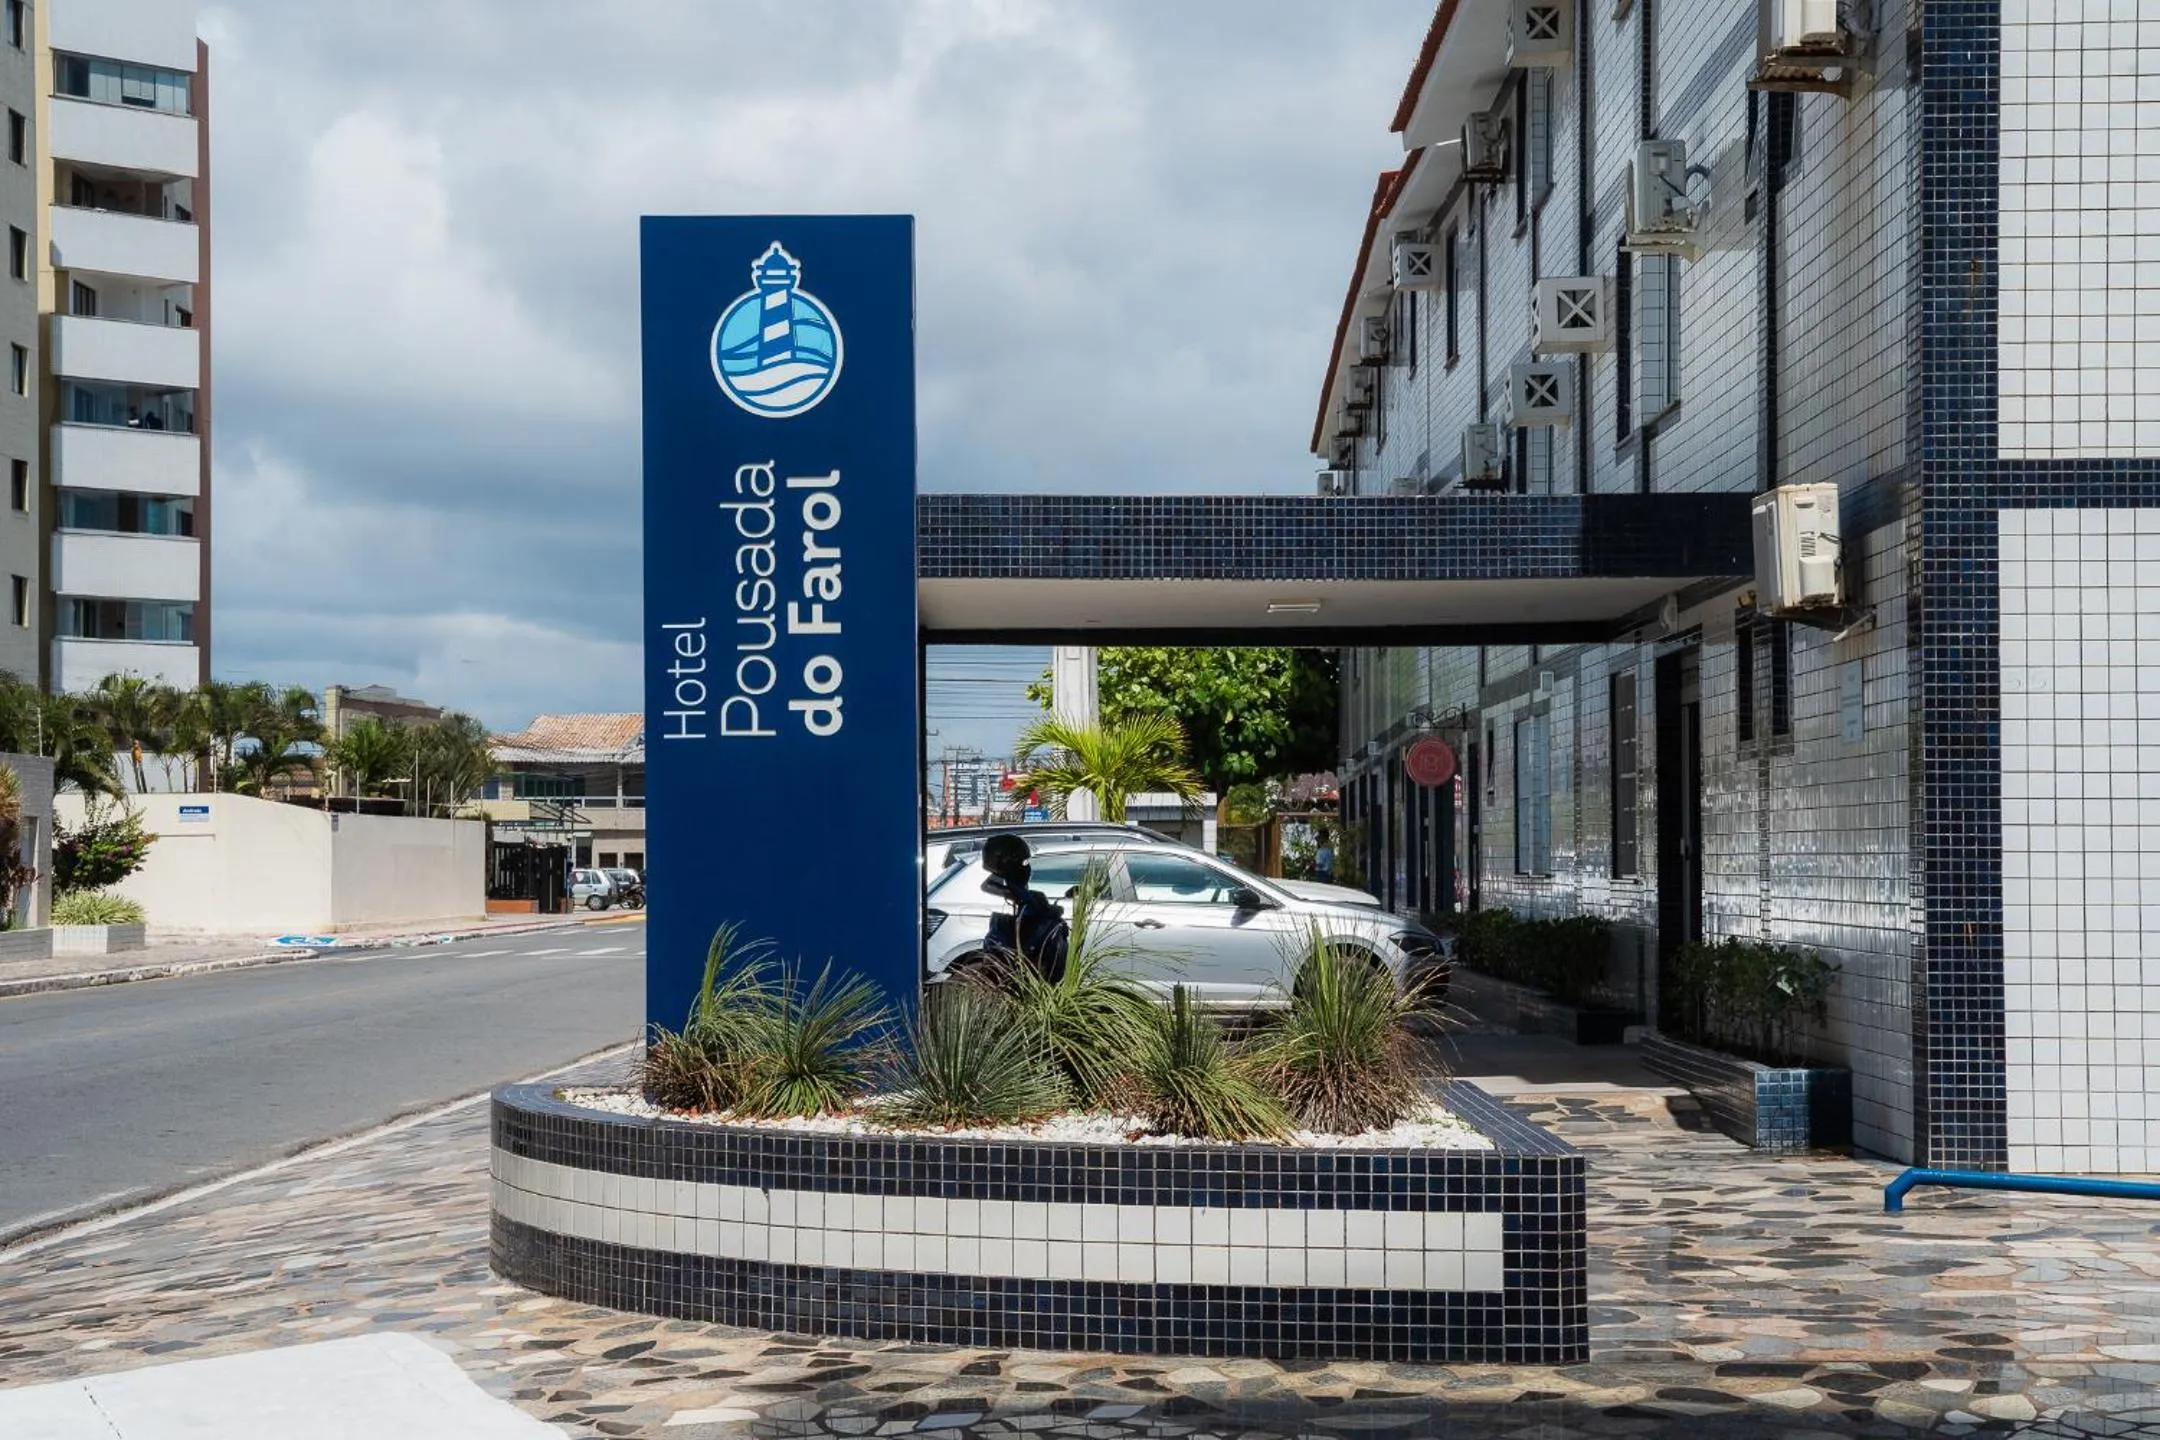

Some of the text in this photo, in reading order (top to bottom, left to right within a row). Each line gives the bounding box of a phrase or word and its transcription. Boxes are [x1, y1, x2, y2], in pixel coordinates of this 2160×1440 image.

[661, 617, 707, 740] Hotel
[720, 459, 777, 736] Pousada
[787, 469, 844, 737] do Farol
